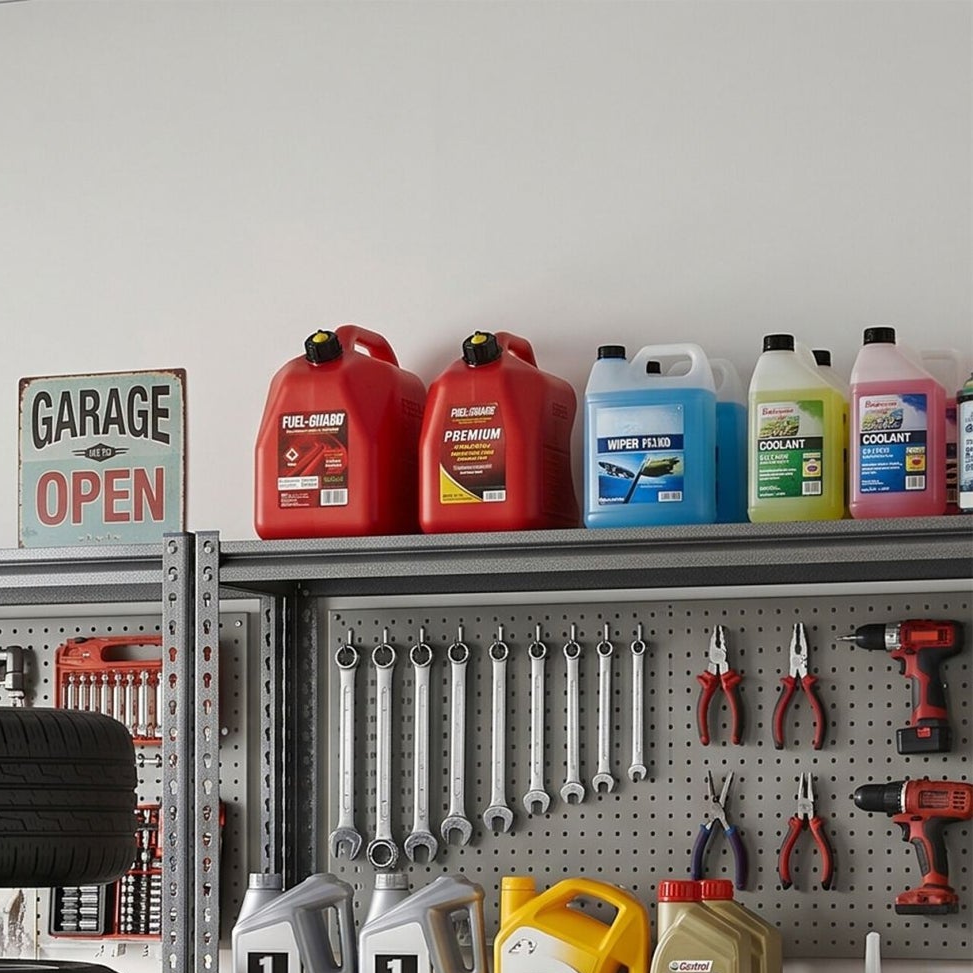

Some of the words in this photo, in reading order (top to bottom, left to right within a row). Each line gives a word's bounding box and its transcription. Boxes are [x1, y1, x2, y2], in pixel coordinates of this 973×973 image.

[31, 384, 170, 450] GARAGE
[607, 438, 640, 451] WIPER
[759, 439, 806, 451] COOLANT
[862, 432, 911, 445] COOLANT
[36, 467, 164, 526] OPEN
